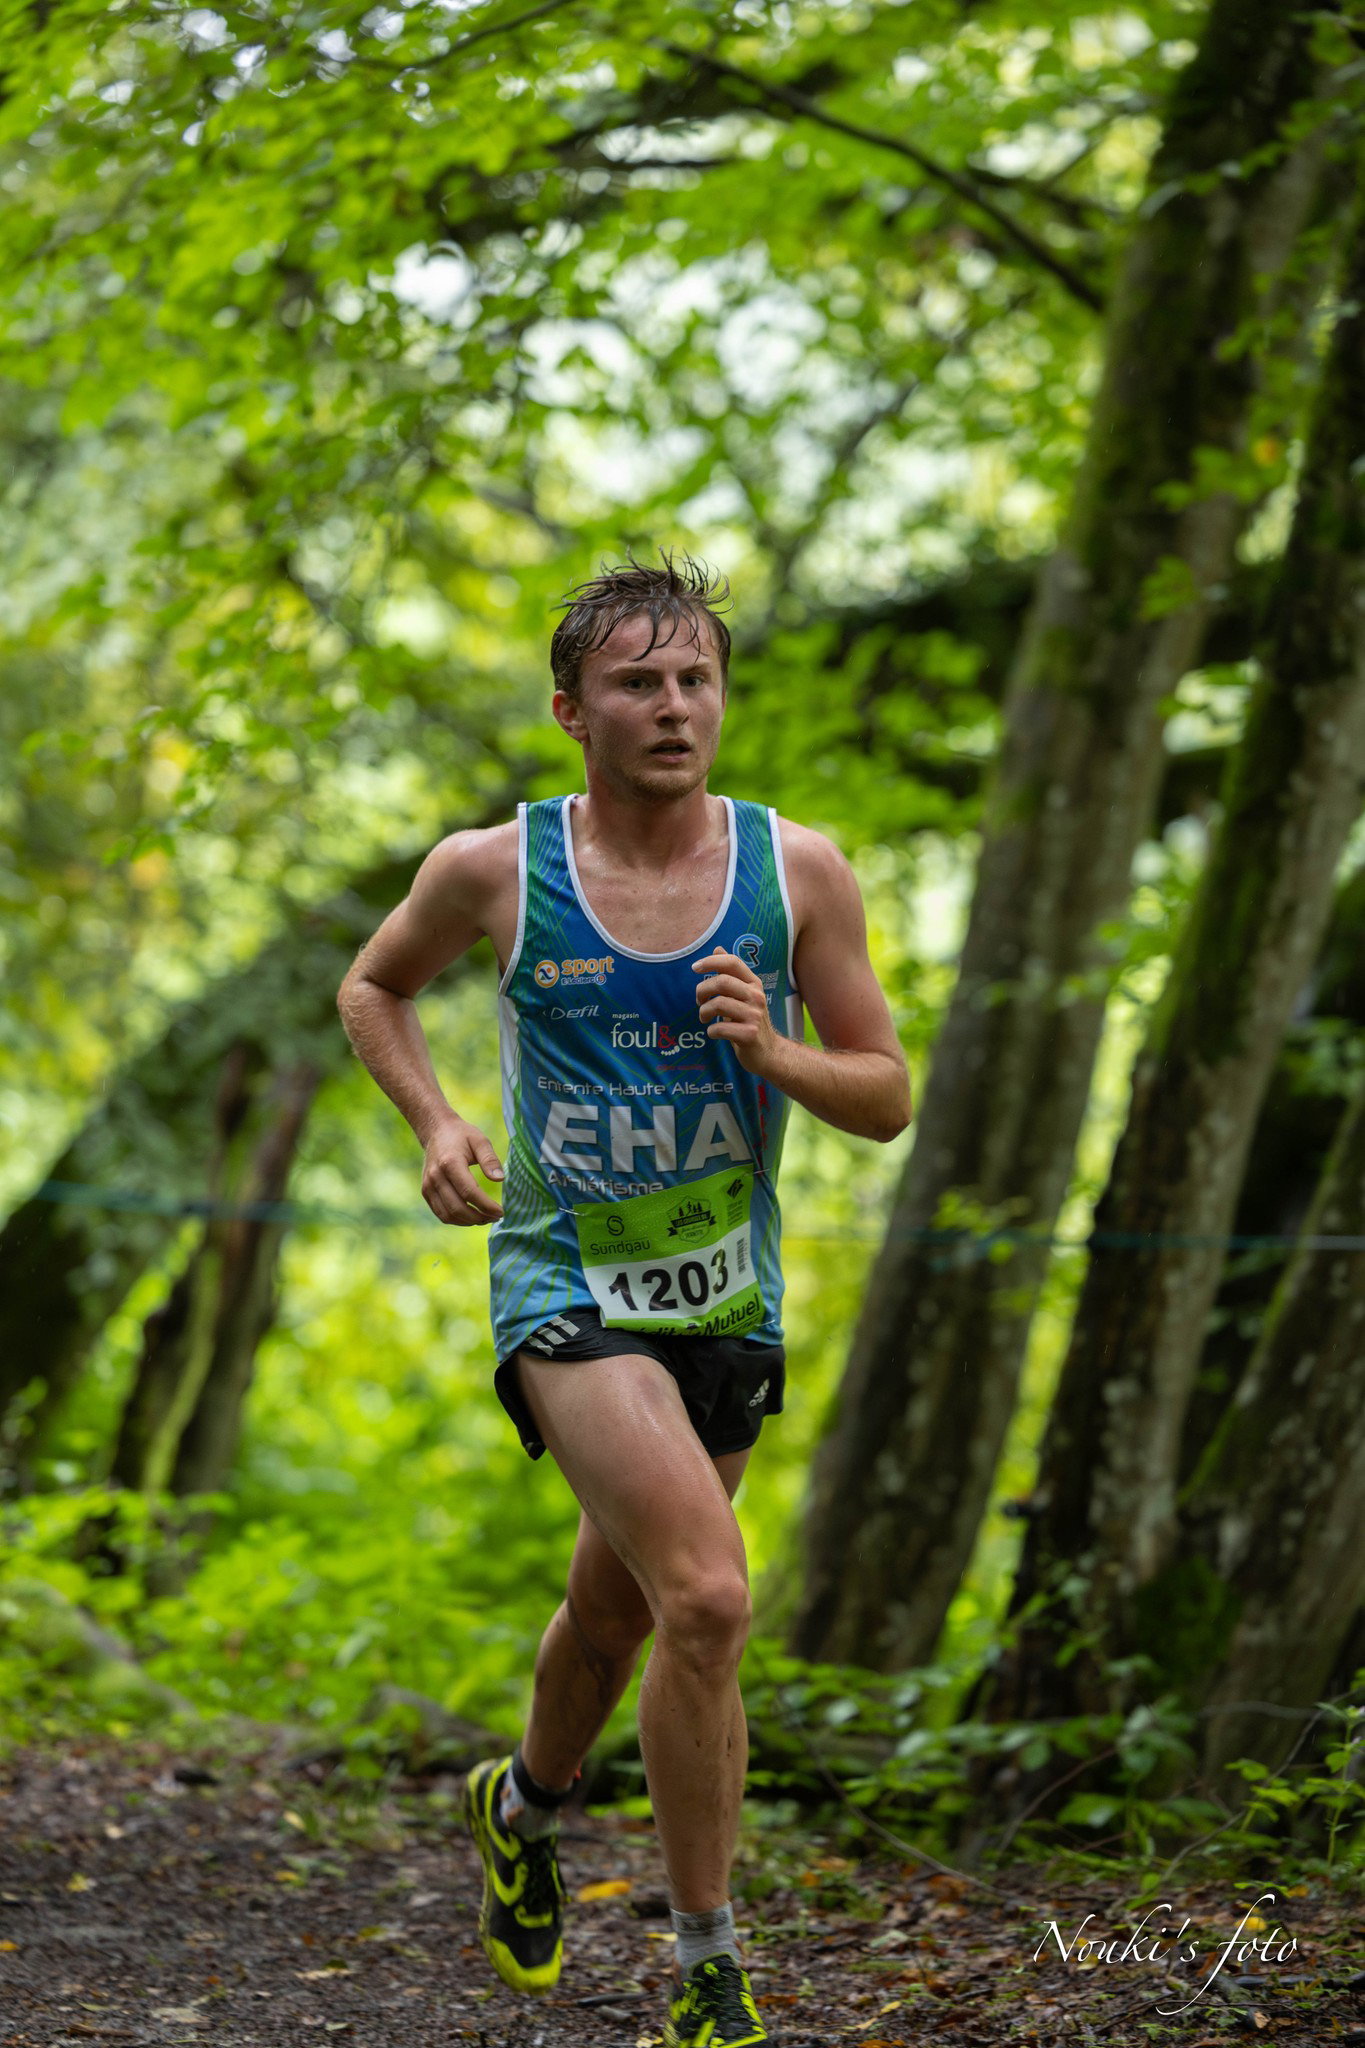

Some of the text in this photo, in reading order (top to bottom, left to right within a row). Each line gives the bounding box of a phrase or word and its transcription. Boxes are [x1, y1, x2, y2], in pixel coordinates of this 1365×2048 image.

[561, 956, 615, 977] sport
[612, 1012, 640, 1020] magasin
[537, 1076, 734, 1097] Entente Haute Alsace
[539, 1101, 753, 1174] EHA
[590, 1239, 651, 1256] Sundgau
[608, 1248, 729, 1312] 1203
[704, 1293, 761, 1335] Mutuel
